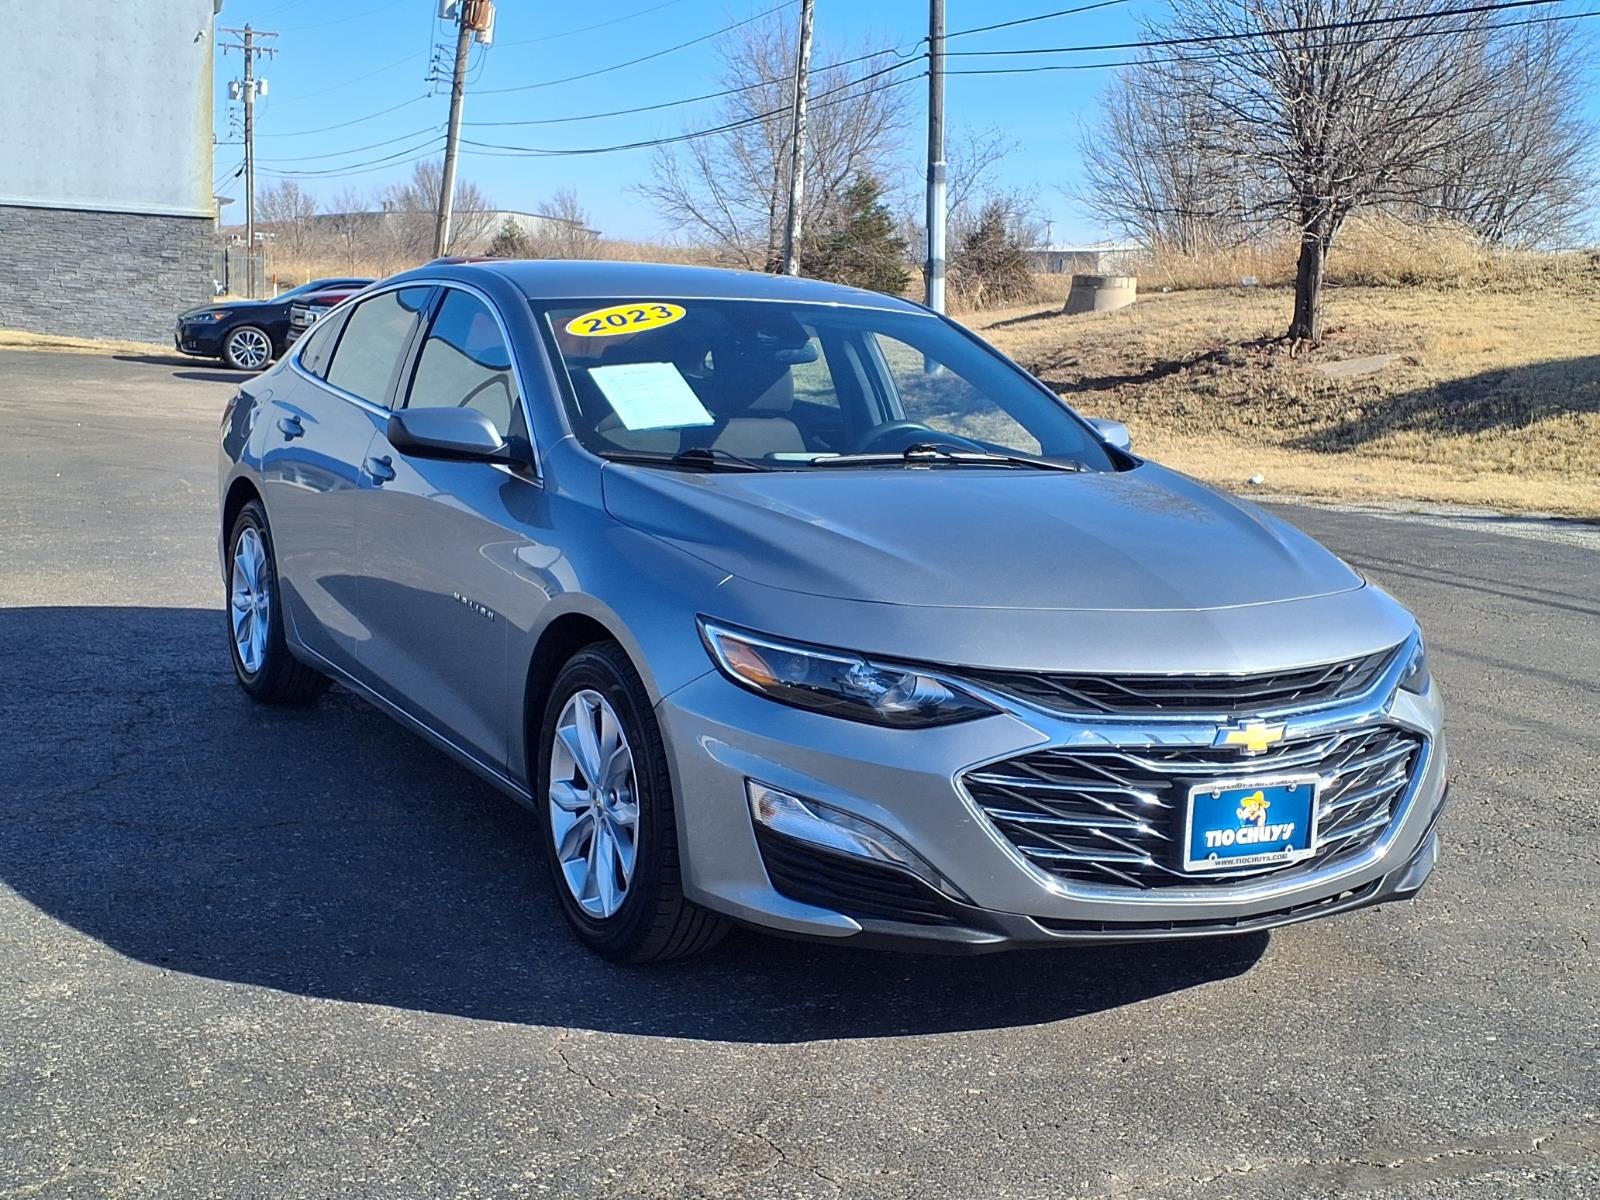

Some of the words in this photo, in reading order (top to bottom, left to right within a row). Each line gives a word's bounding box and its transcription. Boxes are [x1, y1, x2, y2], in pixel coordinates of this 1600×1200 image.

[583, 305, 673, 332] 2023
[1205, 829, 1235, 848] TIO
[1236, 823, 1295, 845] CHUY'S
